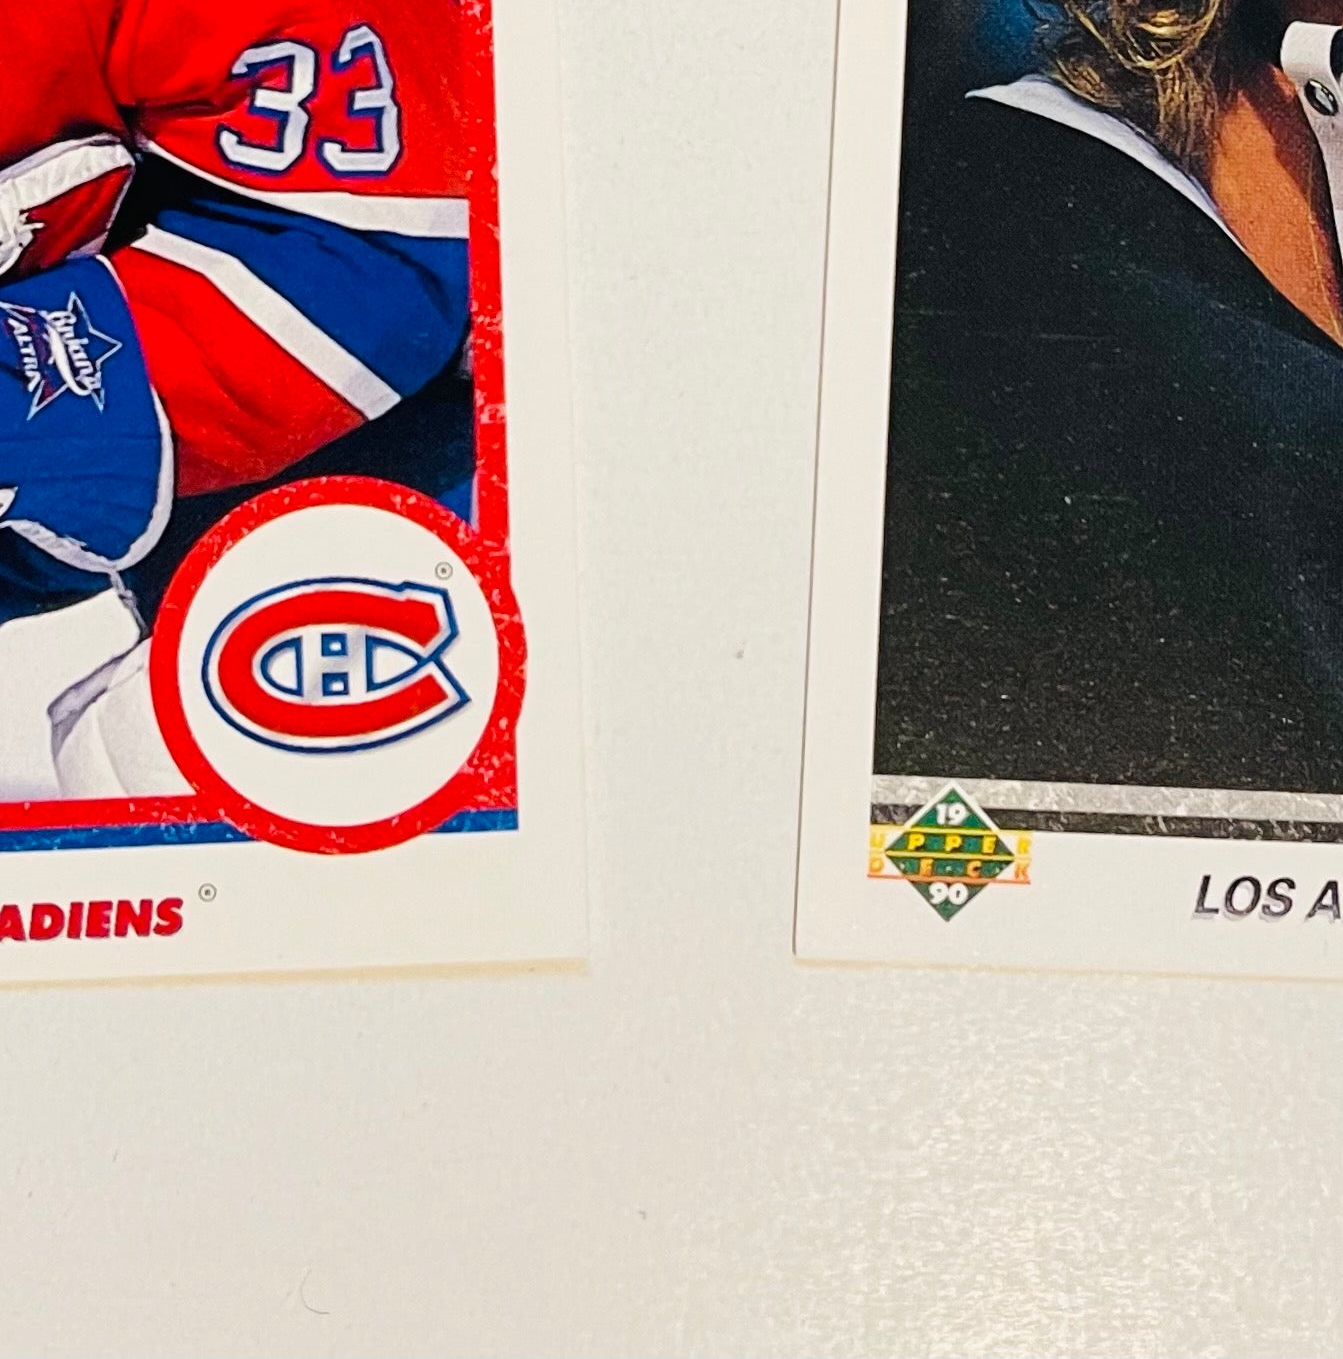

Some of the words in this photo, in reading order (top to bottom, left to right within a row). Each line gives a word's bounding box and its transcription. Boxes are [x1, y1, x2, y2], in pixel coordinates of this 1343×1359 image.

[214, 23, 403, 178] 33
[935, 802, 968, 826] 19
[928, 881, 969, 906] 90
[1192, 874, 1297, 919] LOS
